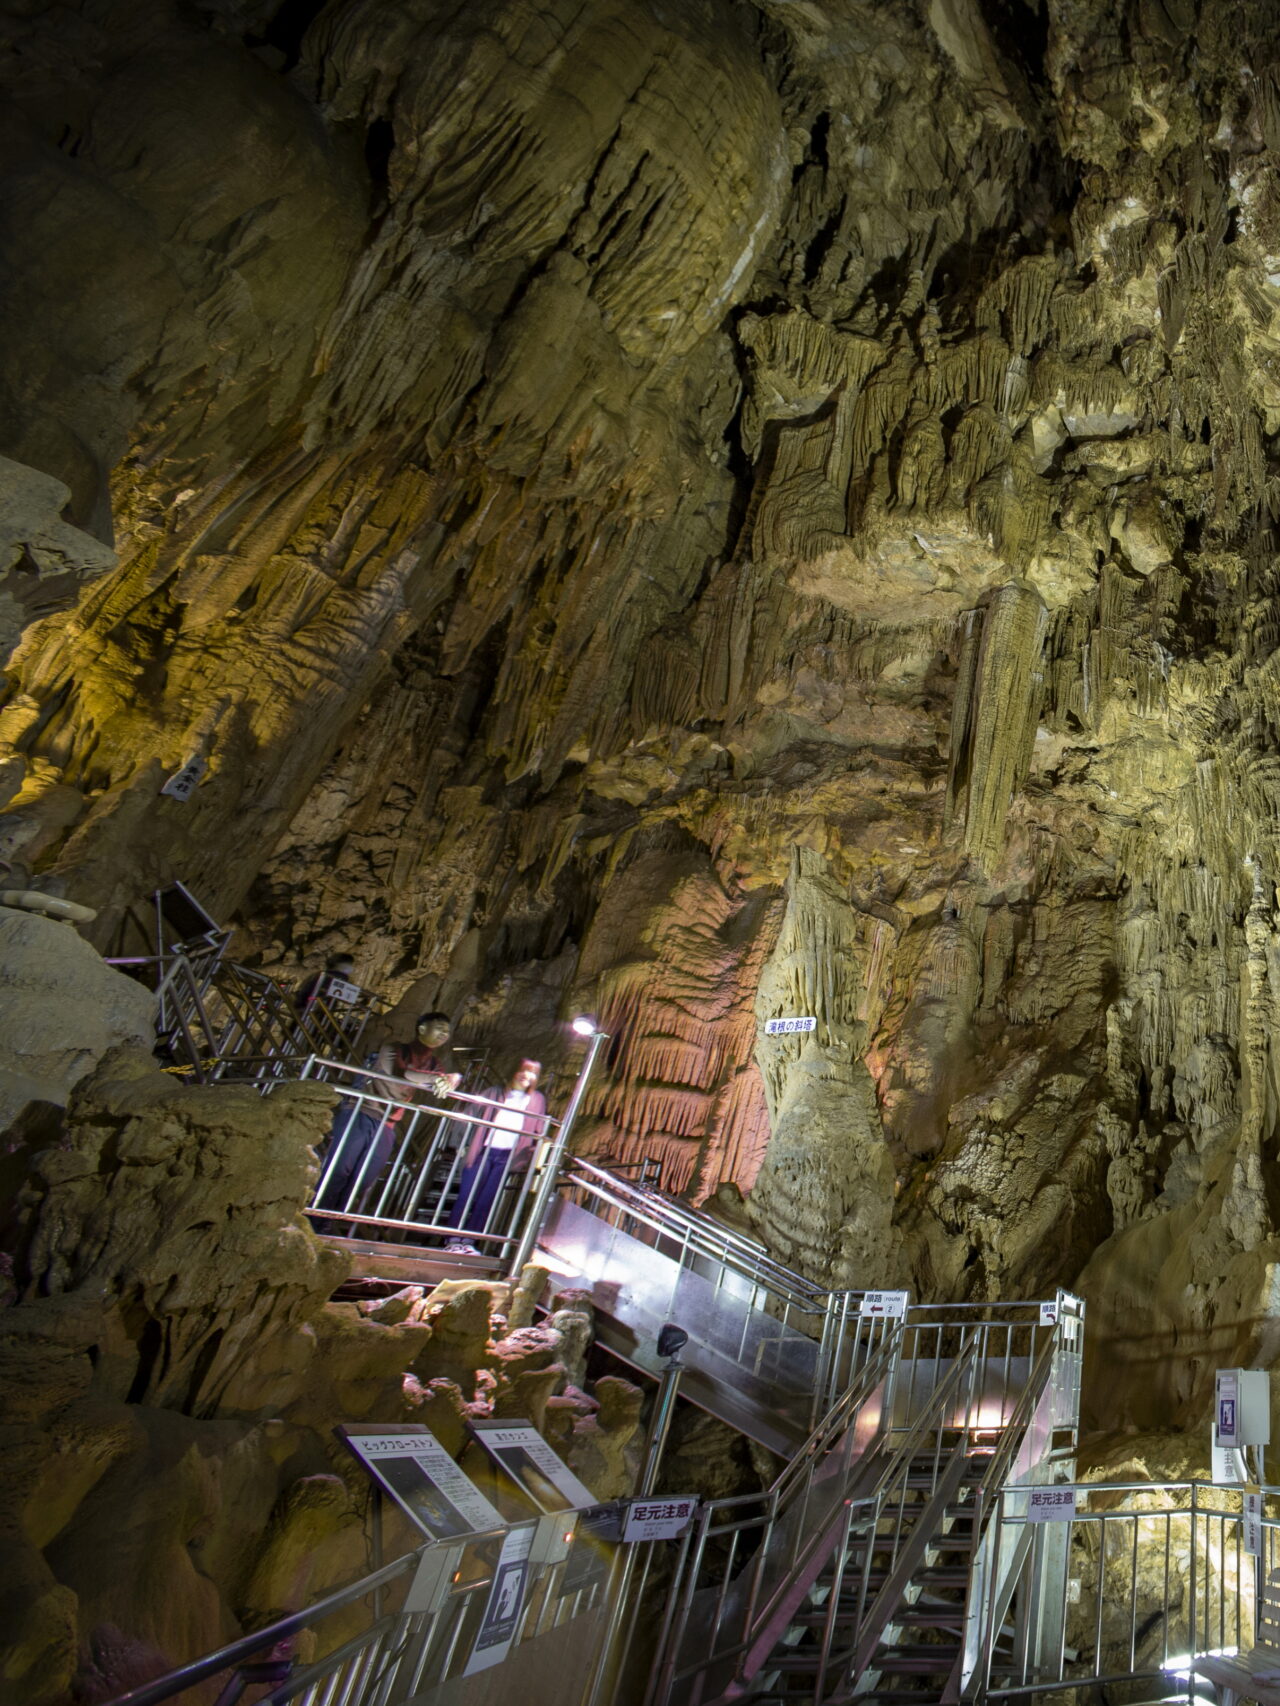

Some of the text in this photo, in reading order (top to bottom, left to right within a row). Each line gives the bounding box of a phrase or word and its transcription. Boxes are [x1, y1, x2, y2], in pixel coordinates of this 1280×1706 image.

[1031, 1492, 1074, 1506] 足元注意
[632, 1503, 691, 1522] 足元注意
